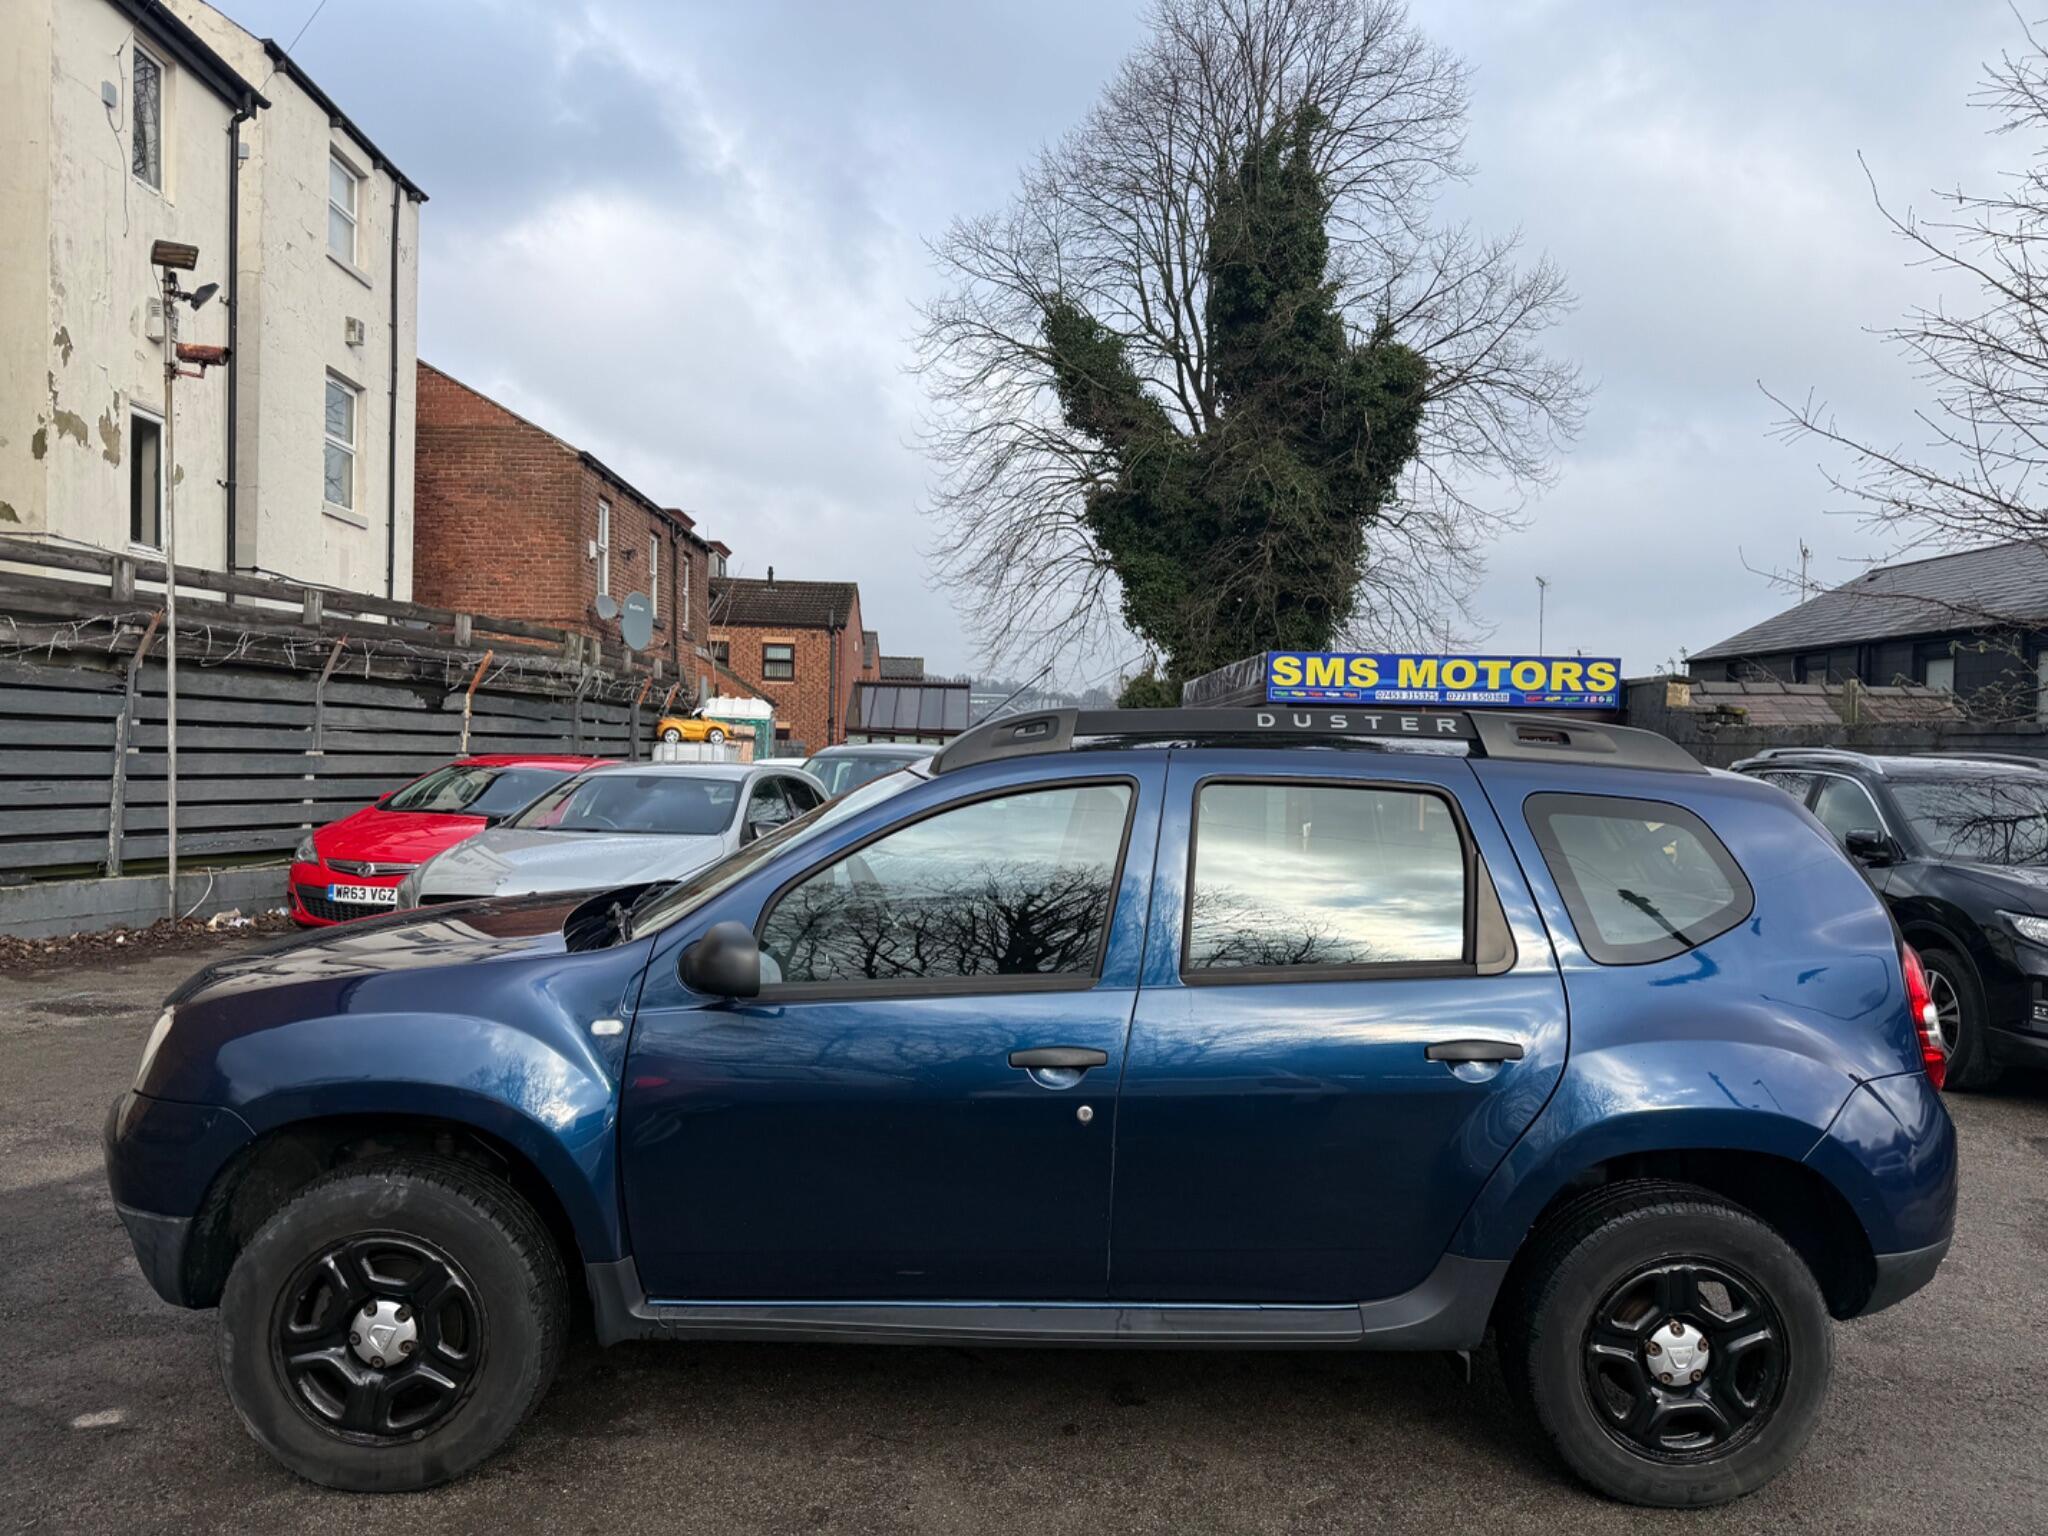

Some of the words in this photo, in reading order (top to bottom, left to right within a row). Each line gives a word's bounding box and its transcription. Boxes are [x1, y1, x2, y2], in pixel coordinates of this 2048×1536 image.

[1272, 656, 1379, 688] SMS
[1398, 659, 1617, 692] MOTORS
[1257, 713, 1457, 733] DUSTER
[336, 886, 366, 900] WR63
[370, 888, 395, 902] VGZ
